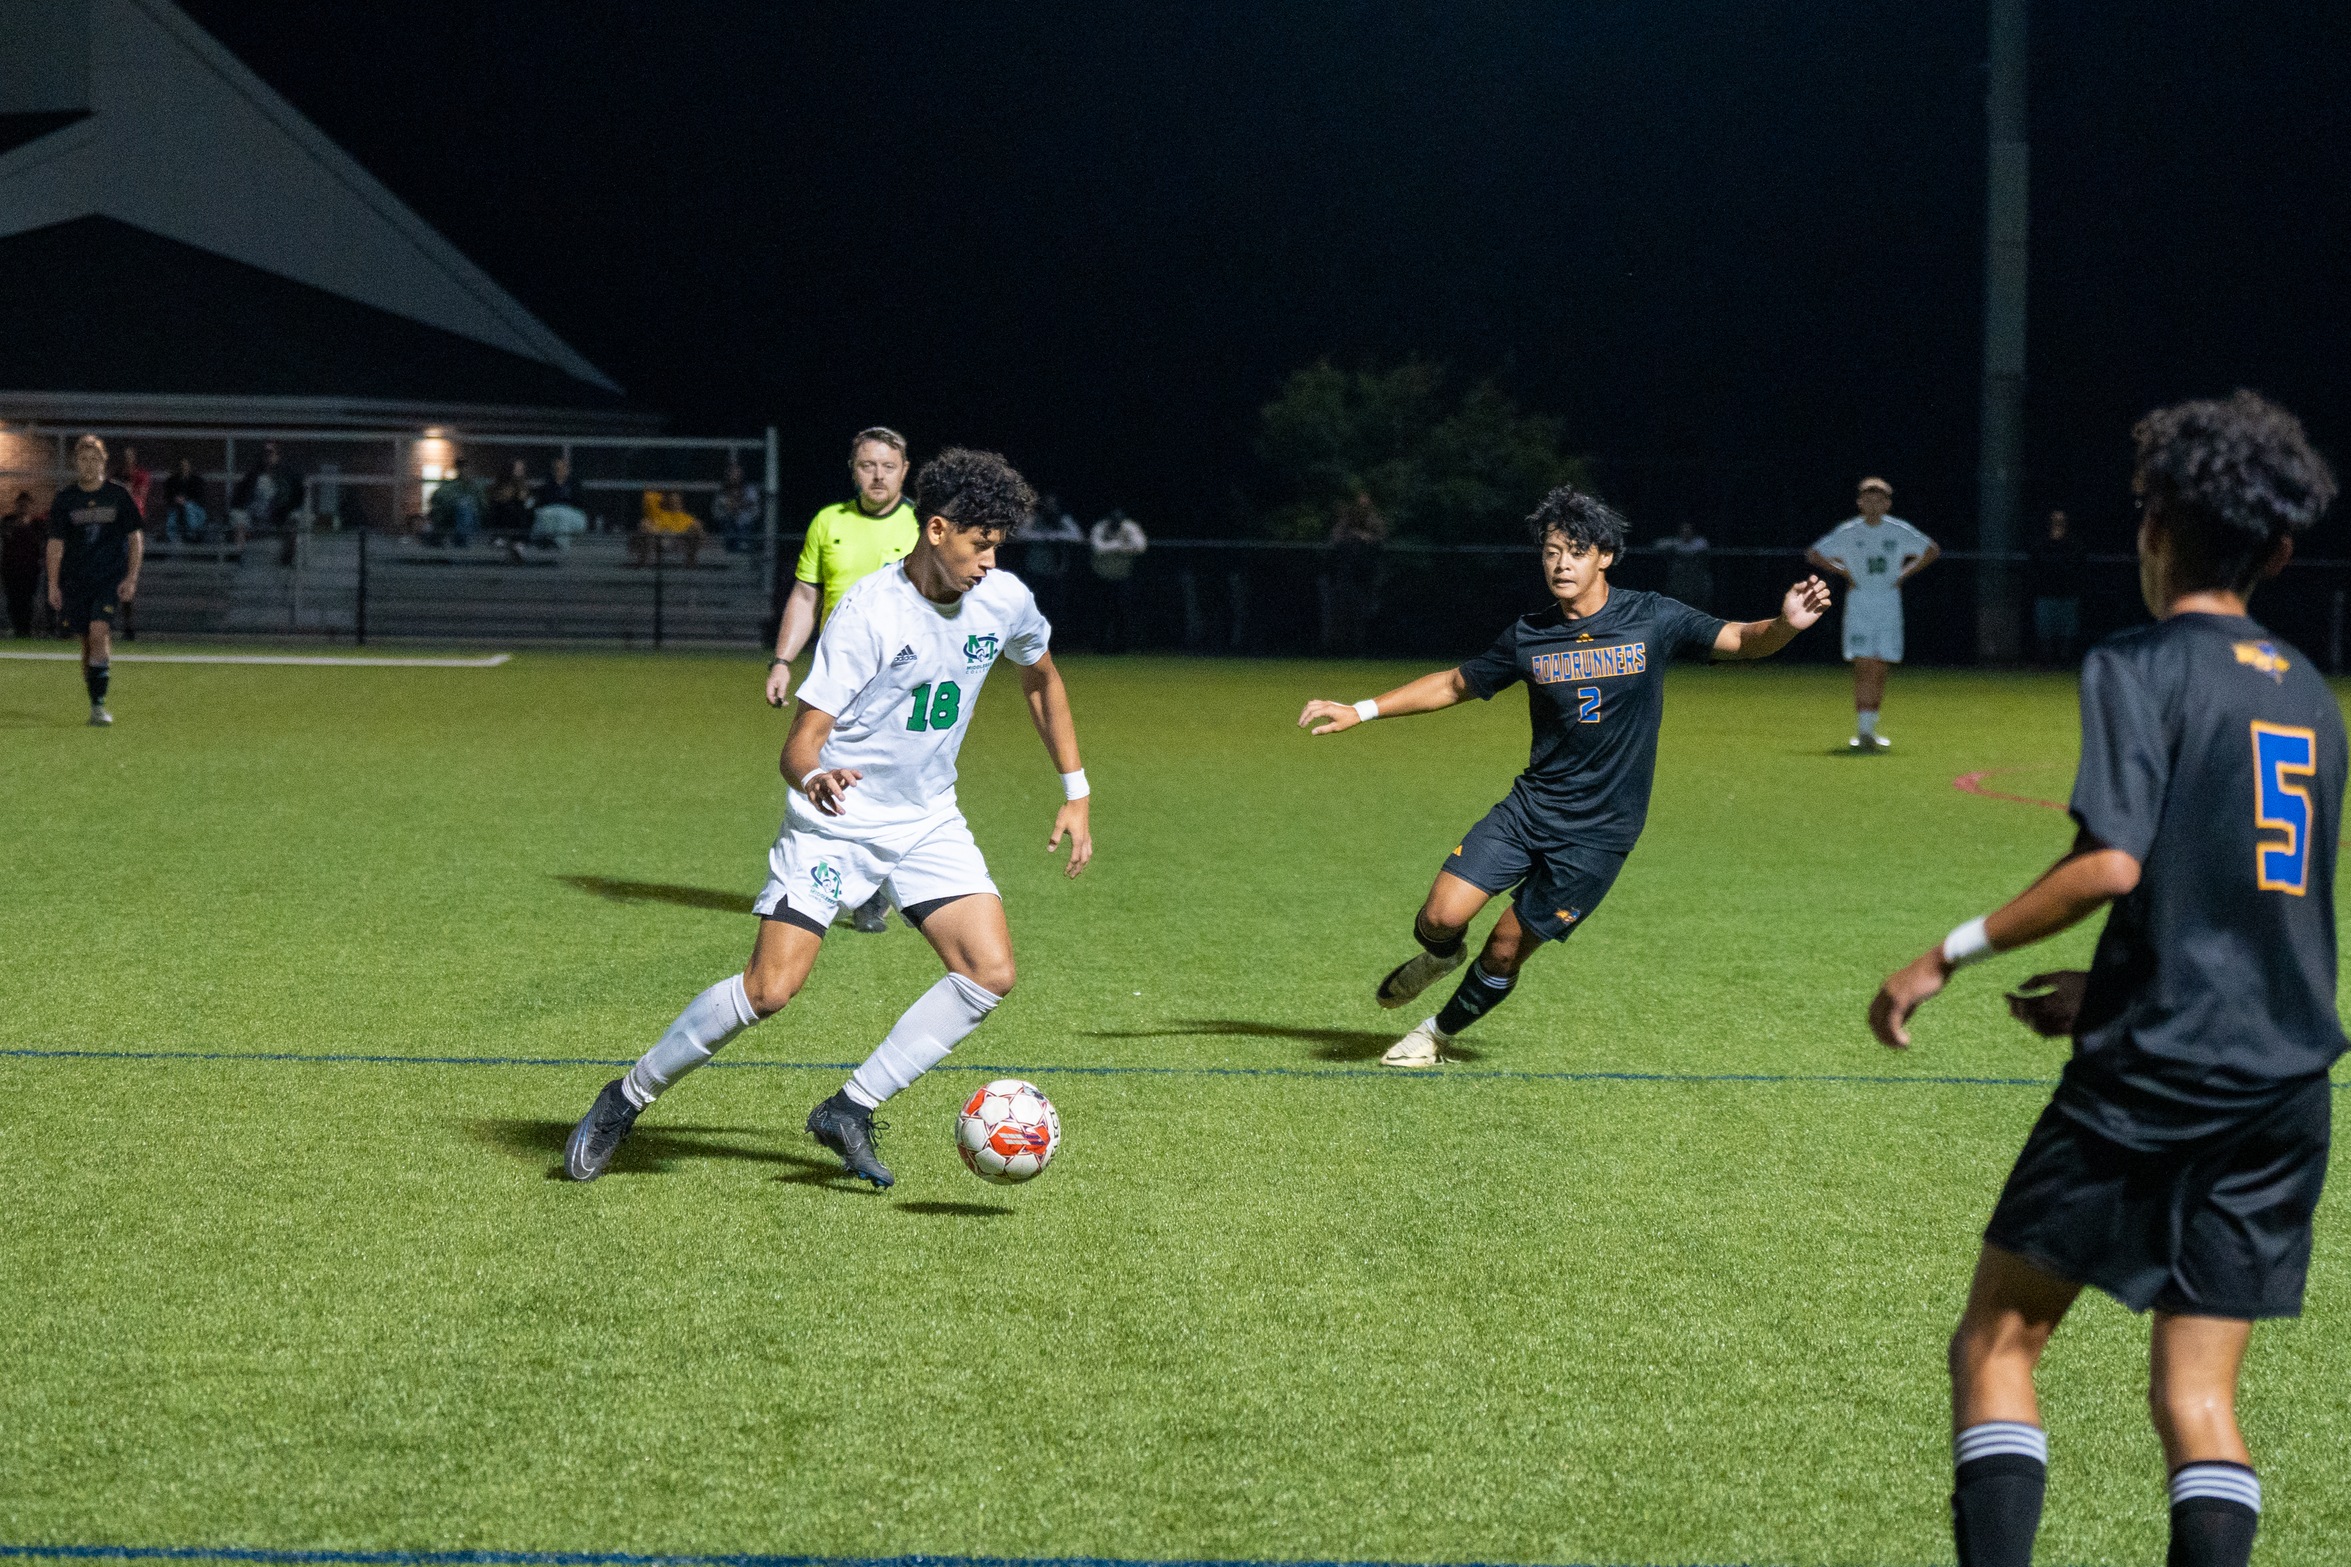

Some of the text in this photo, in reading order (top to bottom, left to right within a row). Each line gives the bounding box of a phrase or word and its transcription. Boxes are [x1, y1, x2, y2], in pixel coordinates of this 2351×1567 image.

[1531, 642, 1646, 684] ROADRUNNERS
[906, 681, 962, 732] 18
[1577, 686, 1602, 723] 2
[2250, 719, 2316, 896] 5
